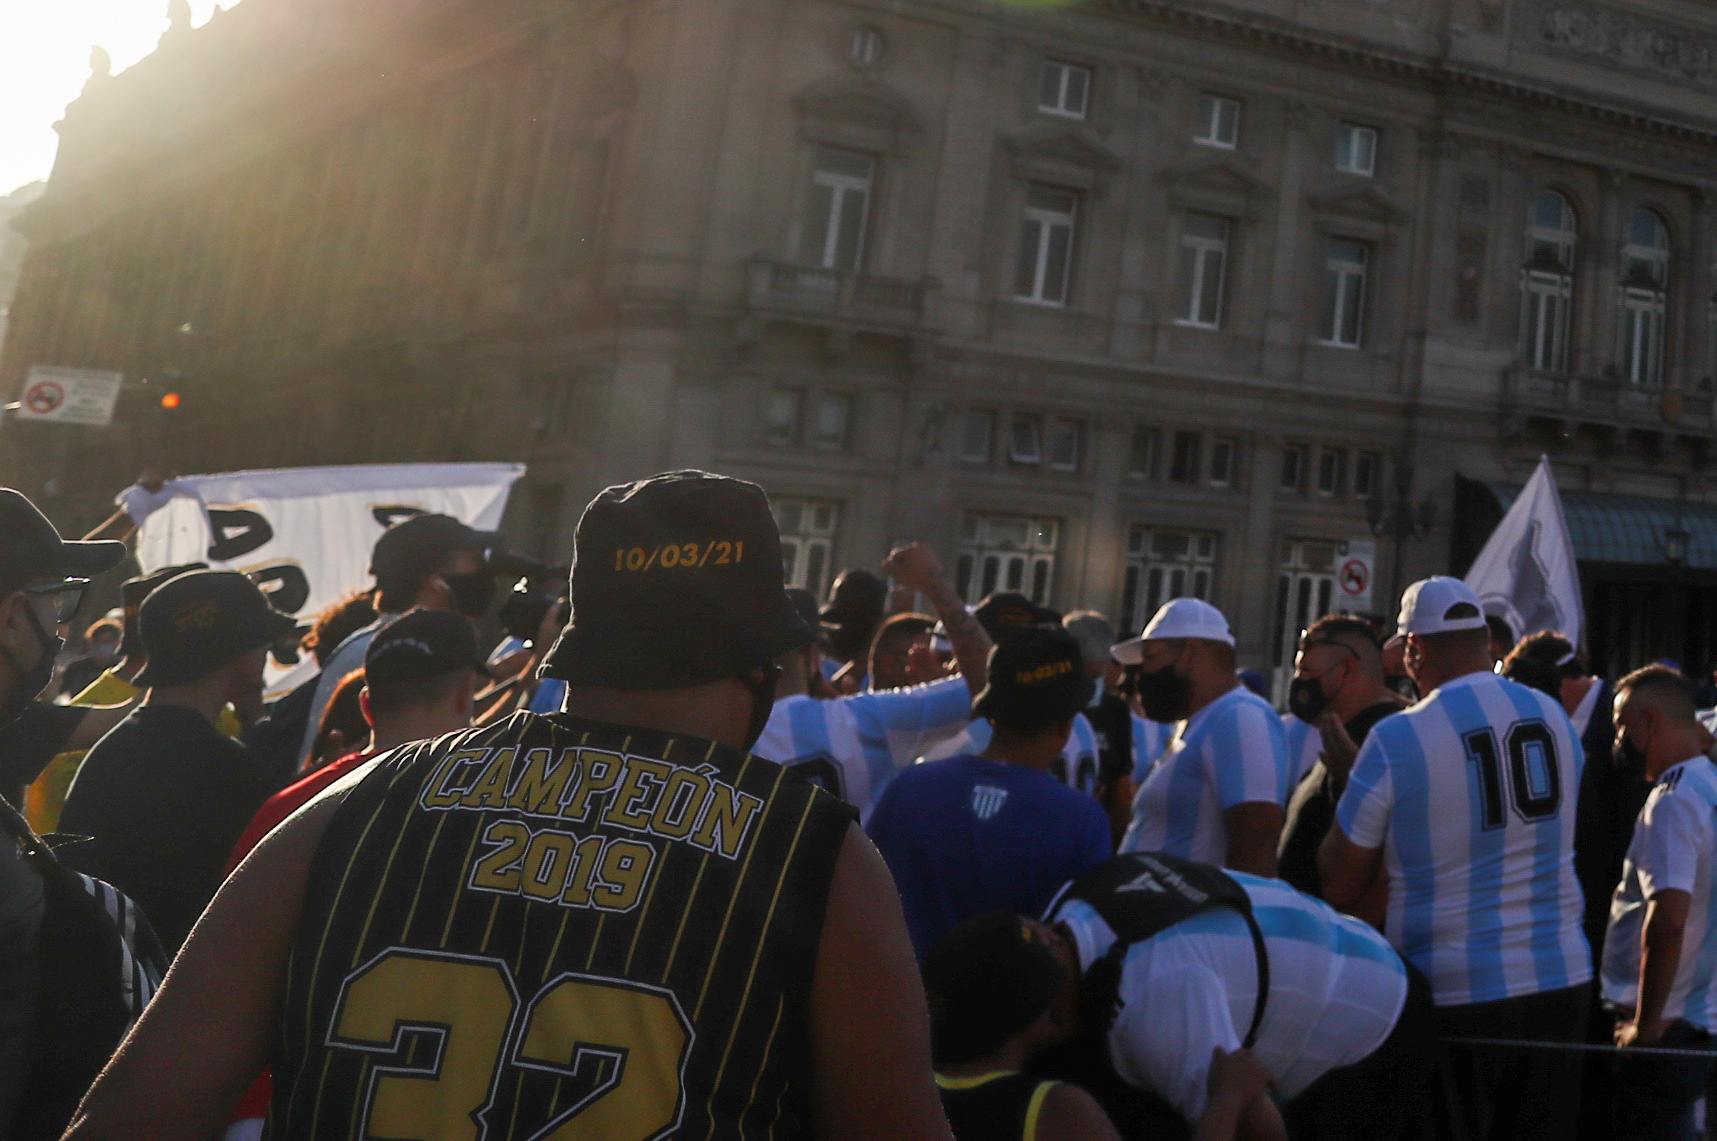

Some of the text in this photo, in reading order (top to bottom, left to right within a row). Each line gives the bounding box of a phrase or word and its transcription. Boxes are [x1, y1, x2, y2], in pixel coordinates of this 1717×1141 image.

[614, 540, 744, 572] 10/03/21
[419, 743, 764, 860] CAMPEÓN
[1462, 717, 1562, 832] 10
[467, 819, 657, 914] 2019
[324, 945, 697, 1141] 32
